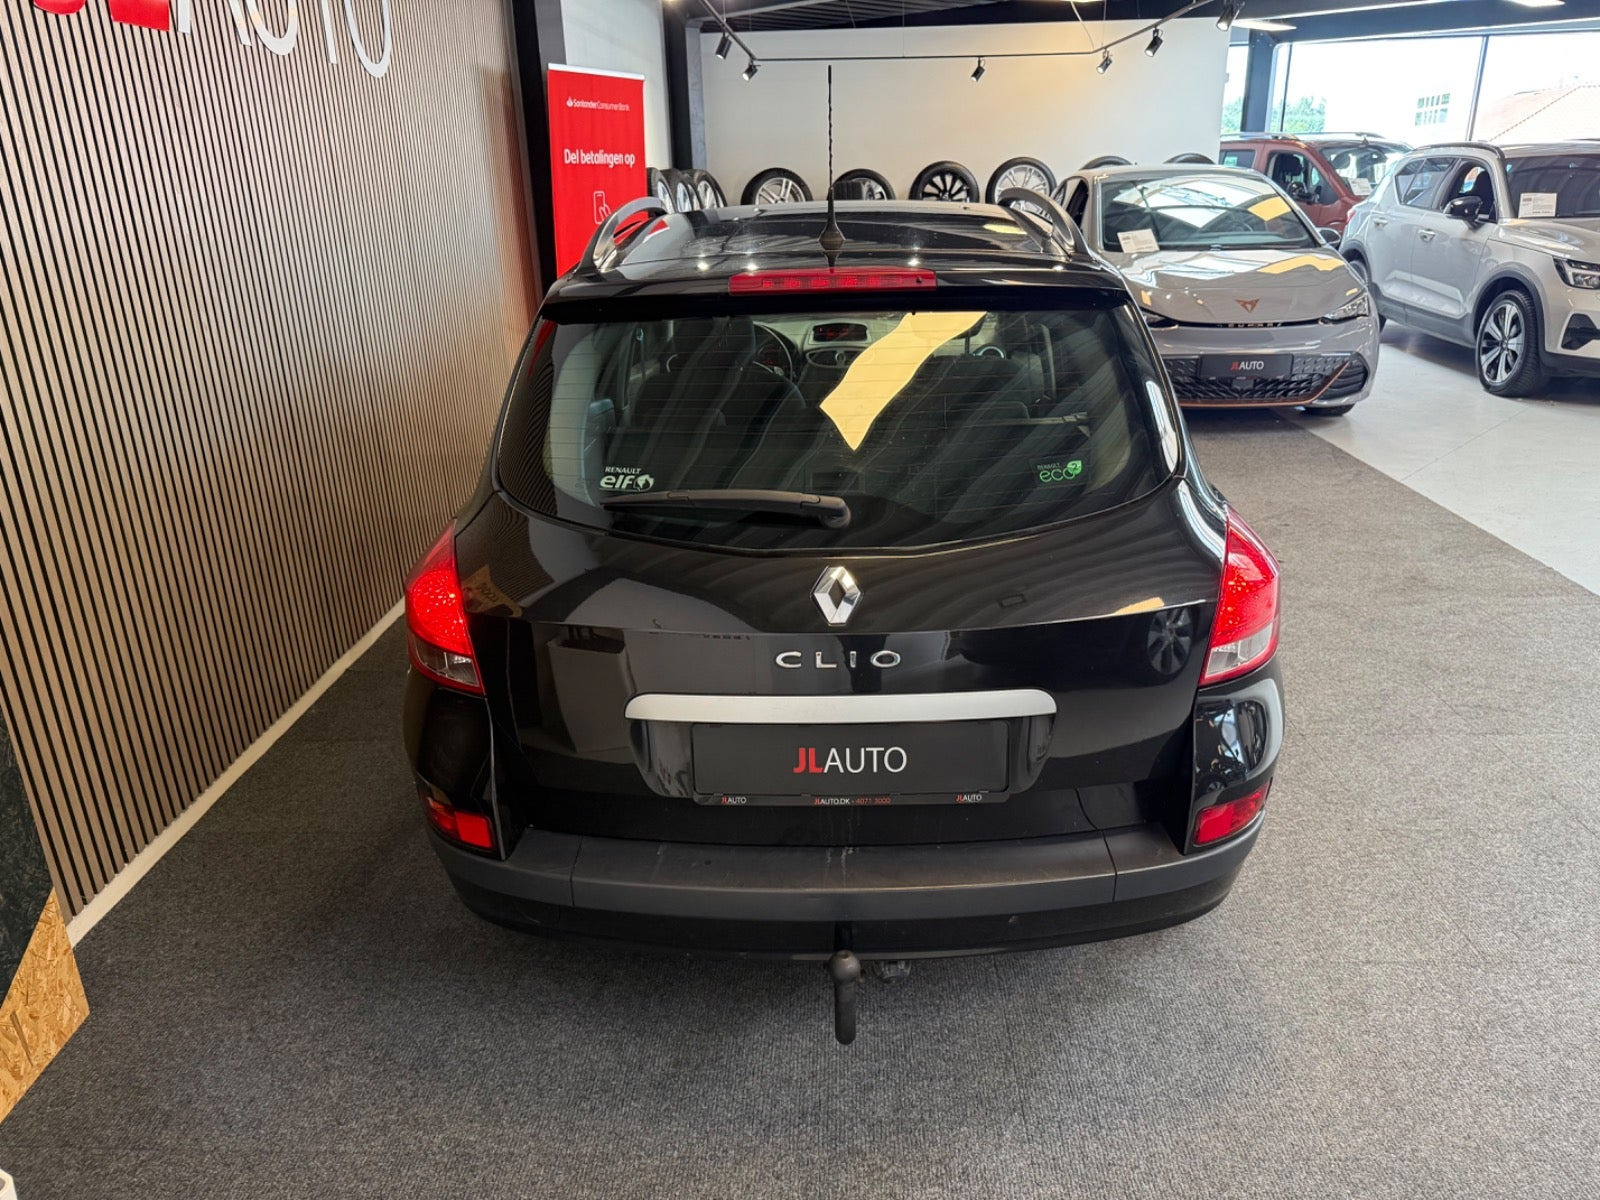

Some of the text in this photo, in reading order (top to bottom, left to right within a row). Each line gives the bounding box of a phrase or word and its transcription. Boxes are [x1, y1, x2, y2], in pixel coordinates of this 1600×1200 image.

[564, 148, 635, 168] Del betalingen op
[605, 466, 641, 474] RENAULT
[600, 475, 635, 488] elf
[775, 650, 901, 669] CLIO
[792, 746, 907, 773] JLAUTO
